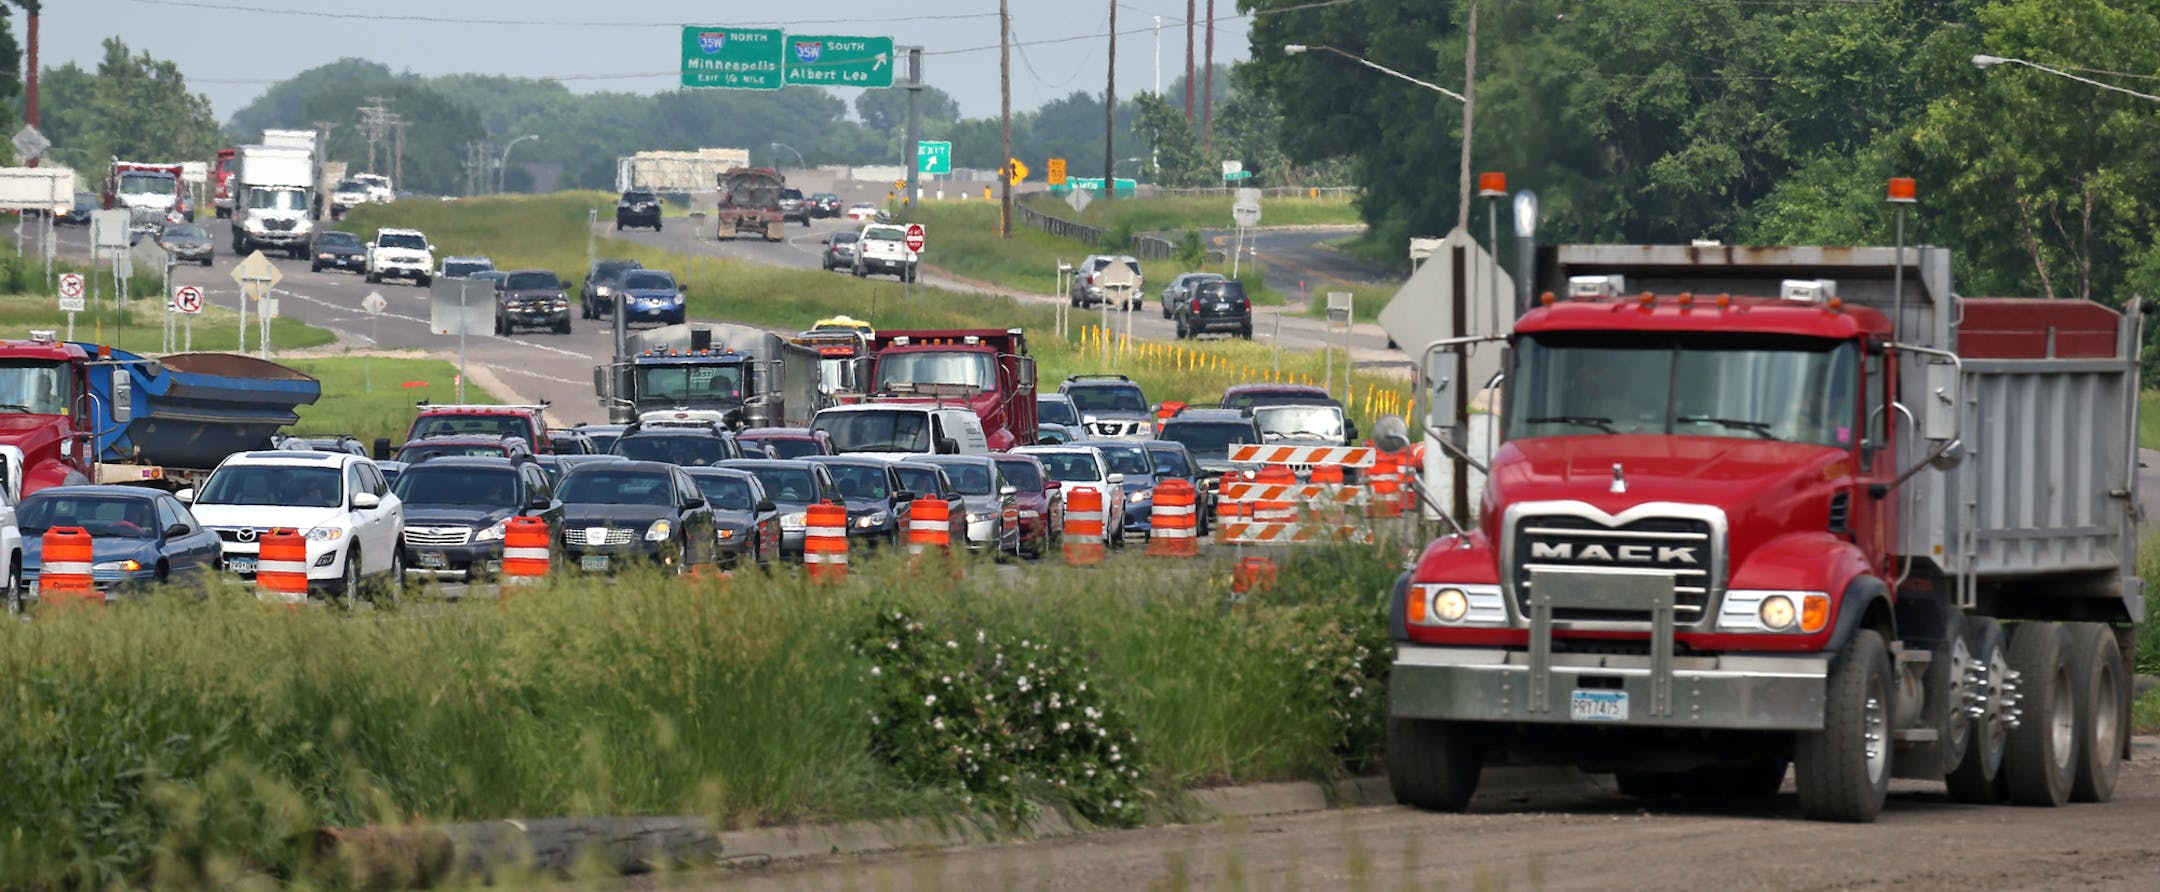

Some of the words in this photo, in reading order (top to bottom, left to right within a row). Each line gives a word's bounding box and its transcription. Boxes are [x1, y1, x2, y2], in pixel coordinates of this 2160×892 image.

[700, 38, 722, 49] 35W
[730, 32, 768, 42] NORTH
[797, 46, 819, 58] 35W
[827, 41, 865, 51] SOUTH
[688, 57, 776, 72] Minneapolis
[790, 68, 837, 81] Albert
[843, 69, 868, 81] Lea
[918, 146, 945, 155] EXIT
[1531, 541, 1699, 564] MACK
